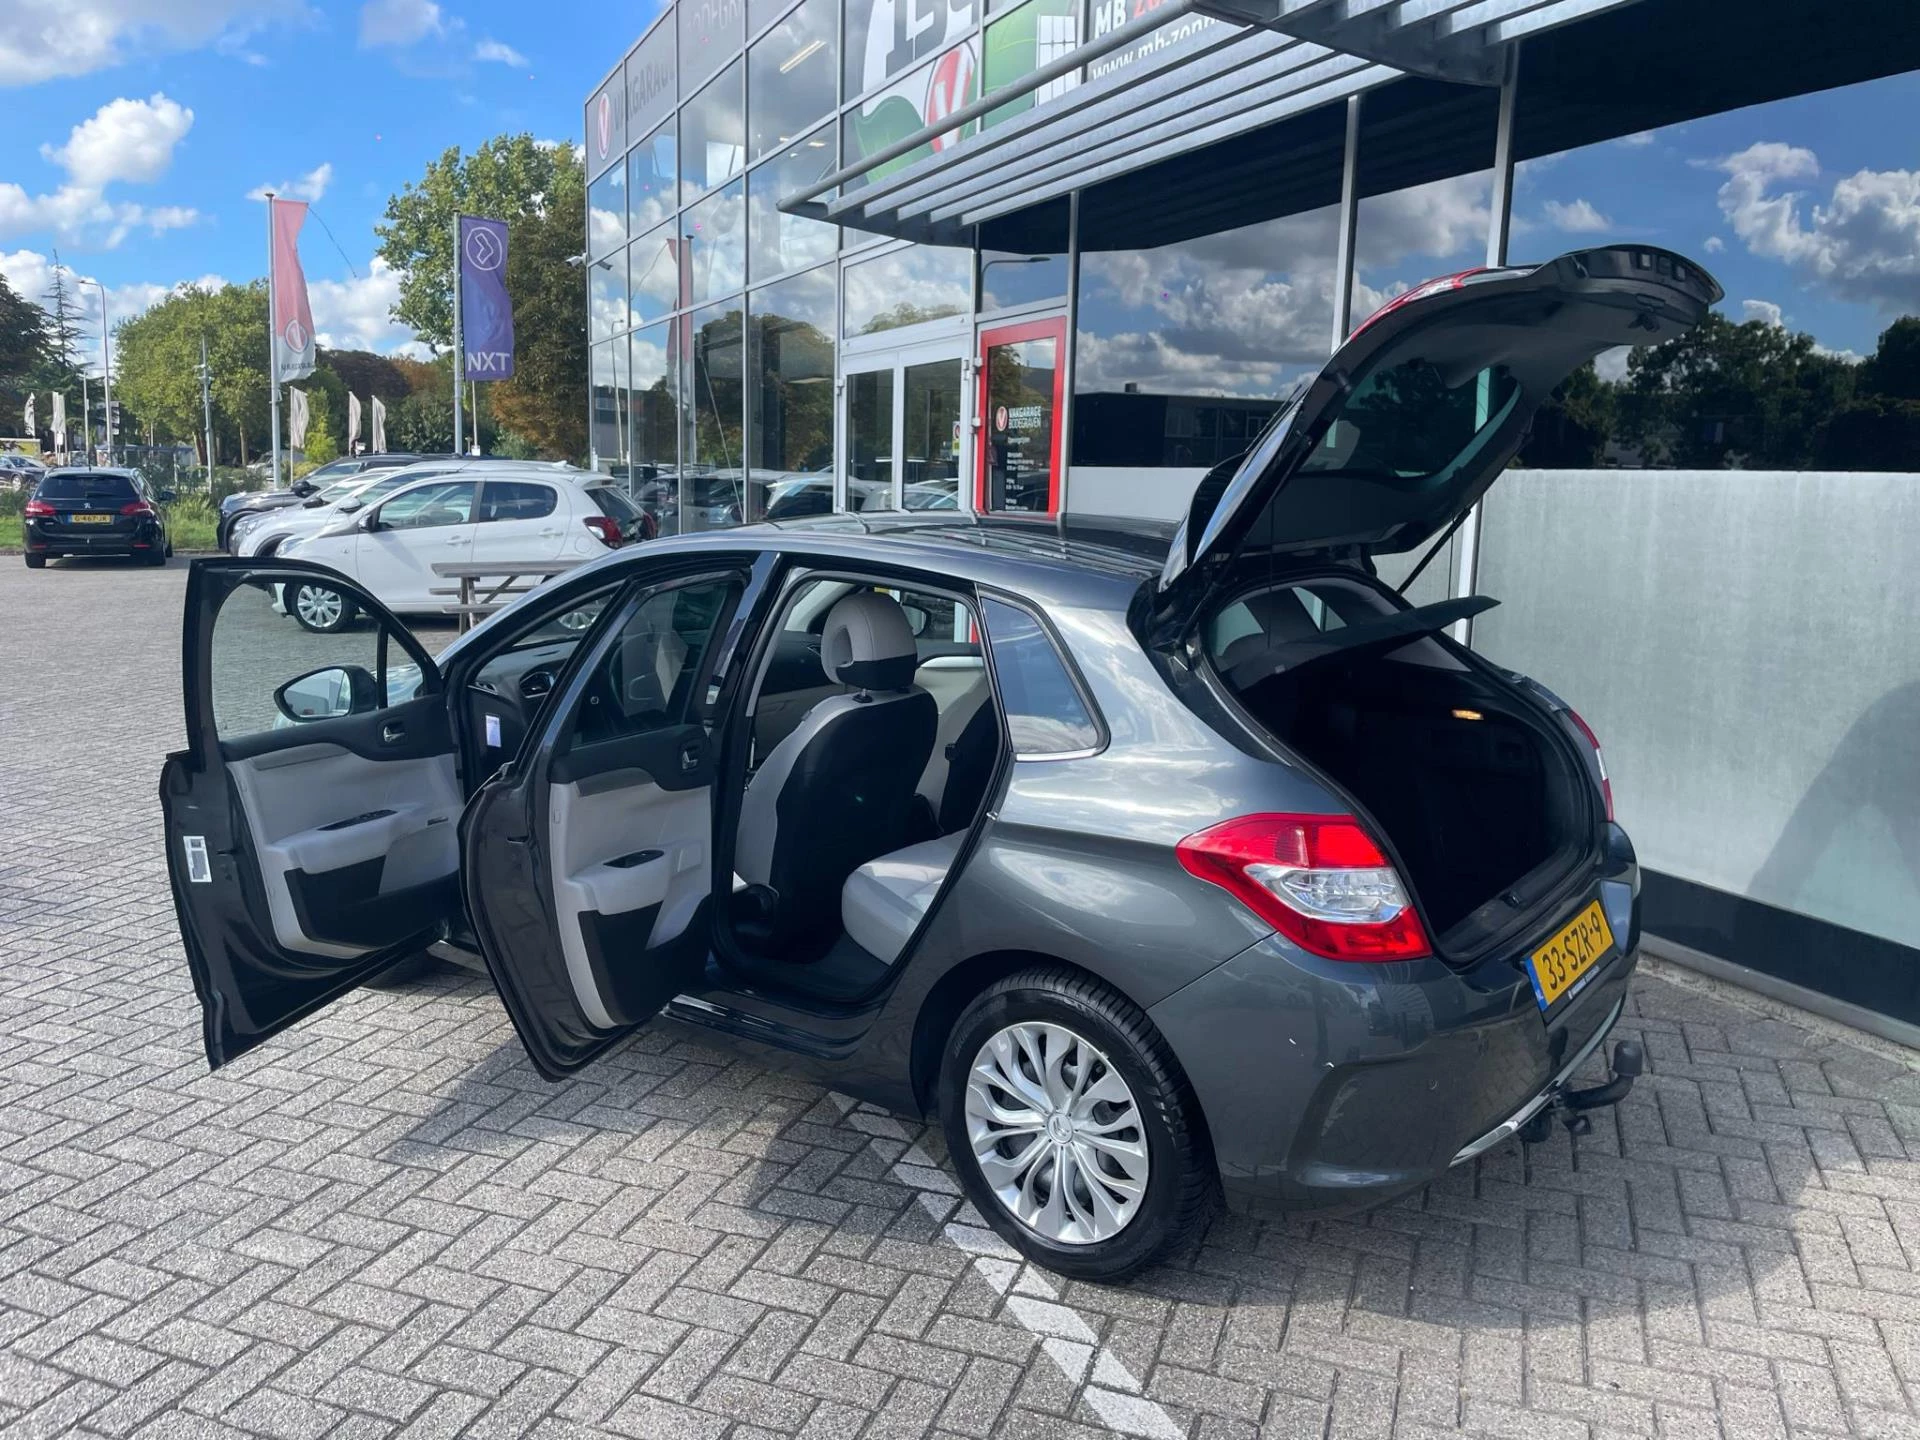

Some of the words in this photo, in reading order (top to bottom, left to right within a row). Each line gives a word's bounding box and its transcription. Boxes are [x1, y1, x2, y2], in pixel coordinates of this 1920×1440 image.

[1095, 0, 1126, 40] MB
[467, 352, 510, 371] NXT
[1542, 911, 1603, 990] 33-SZR-9
